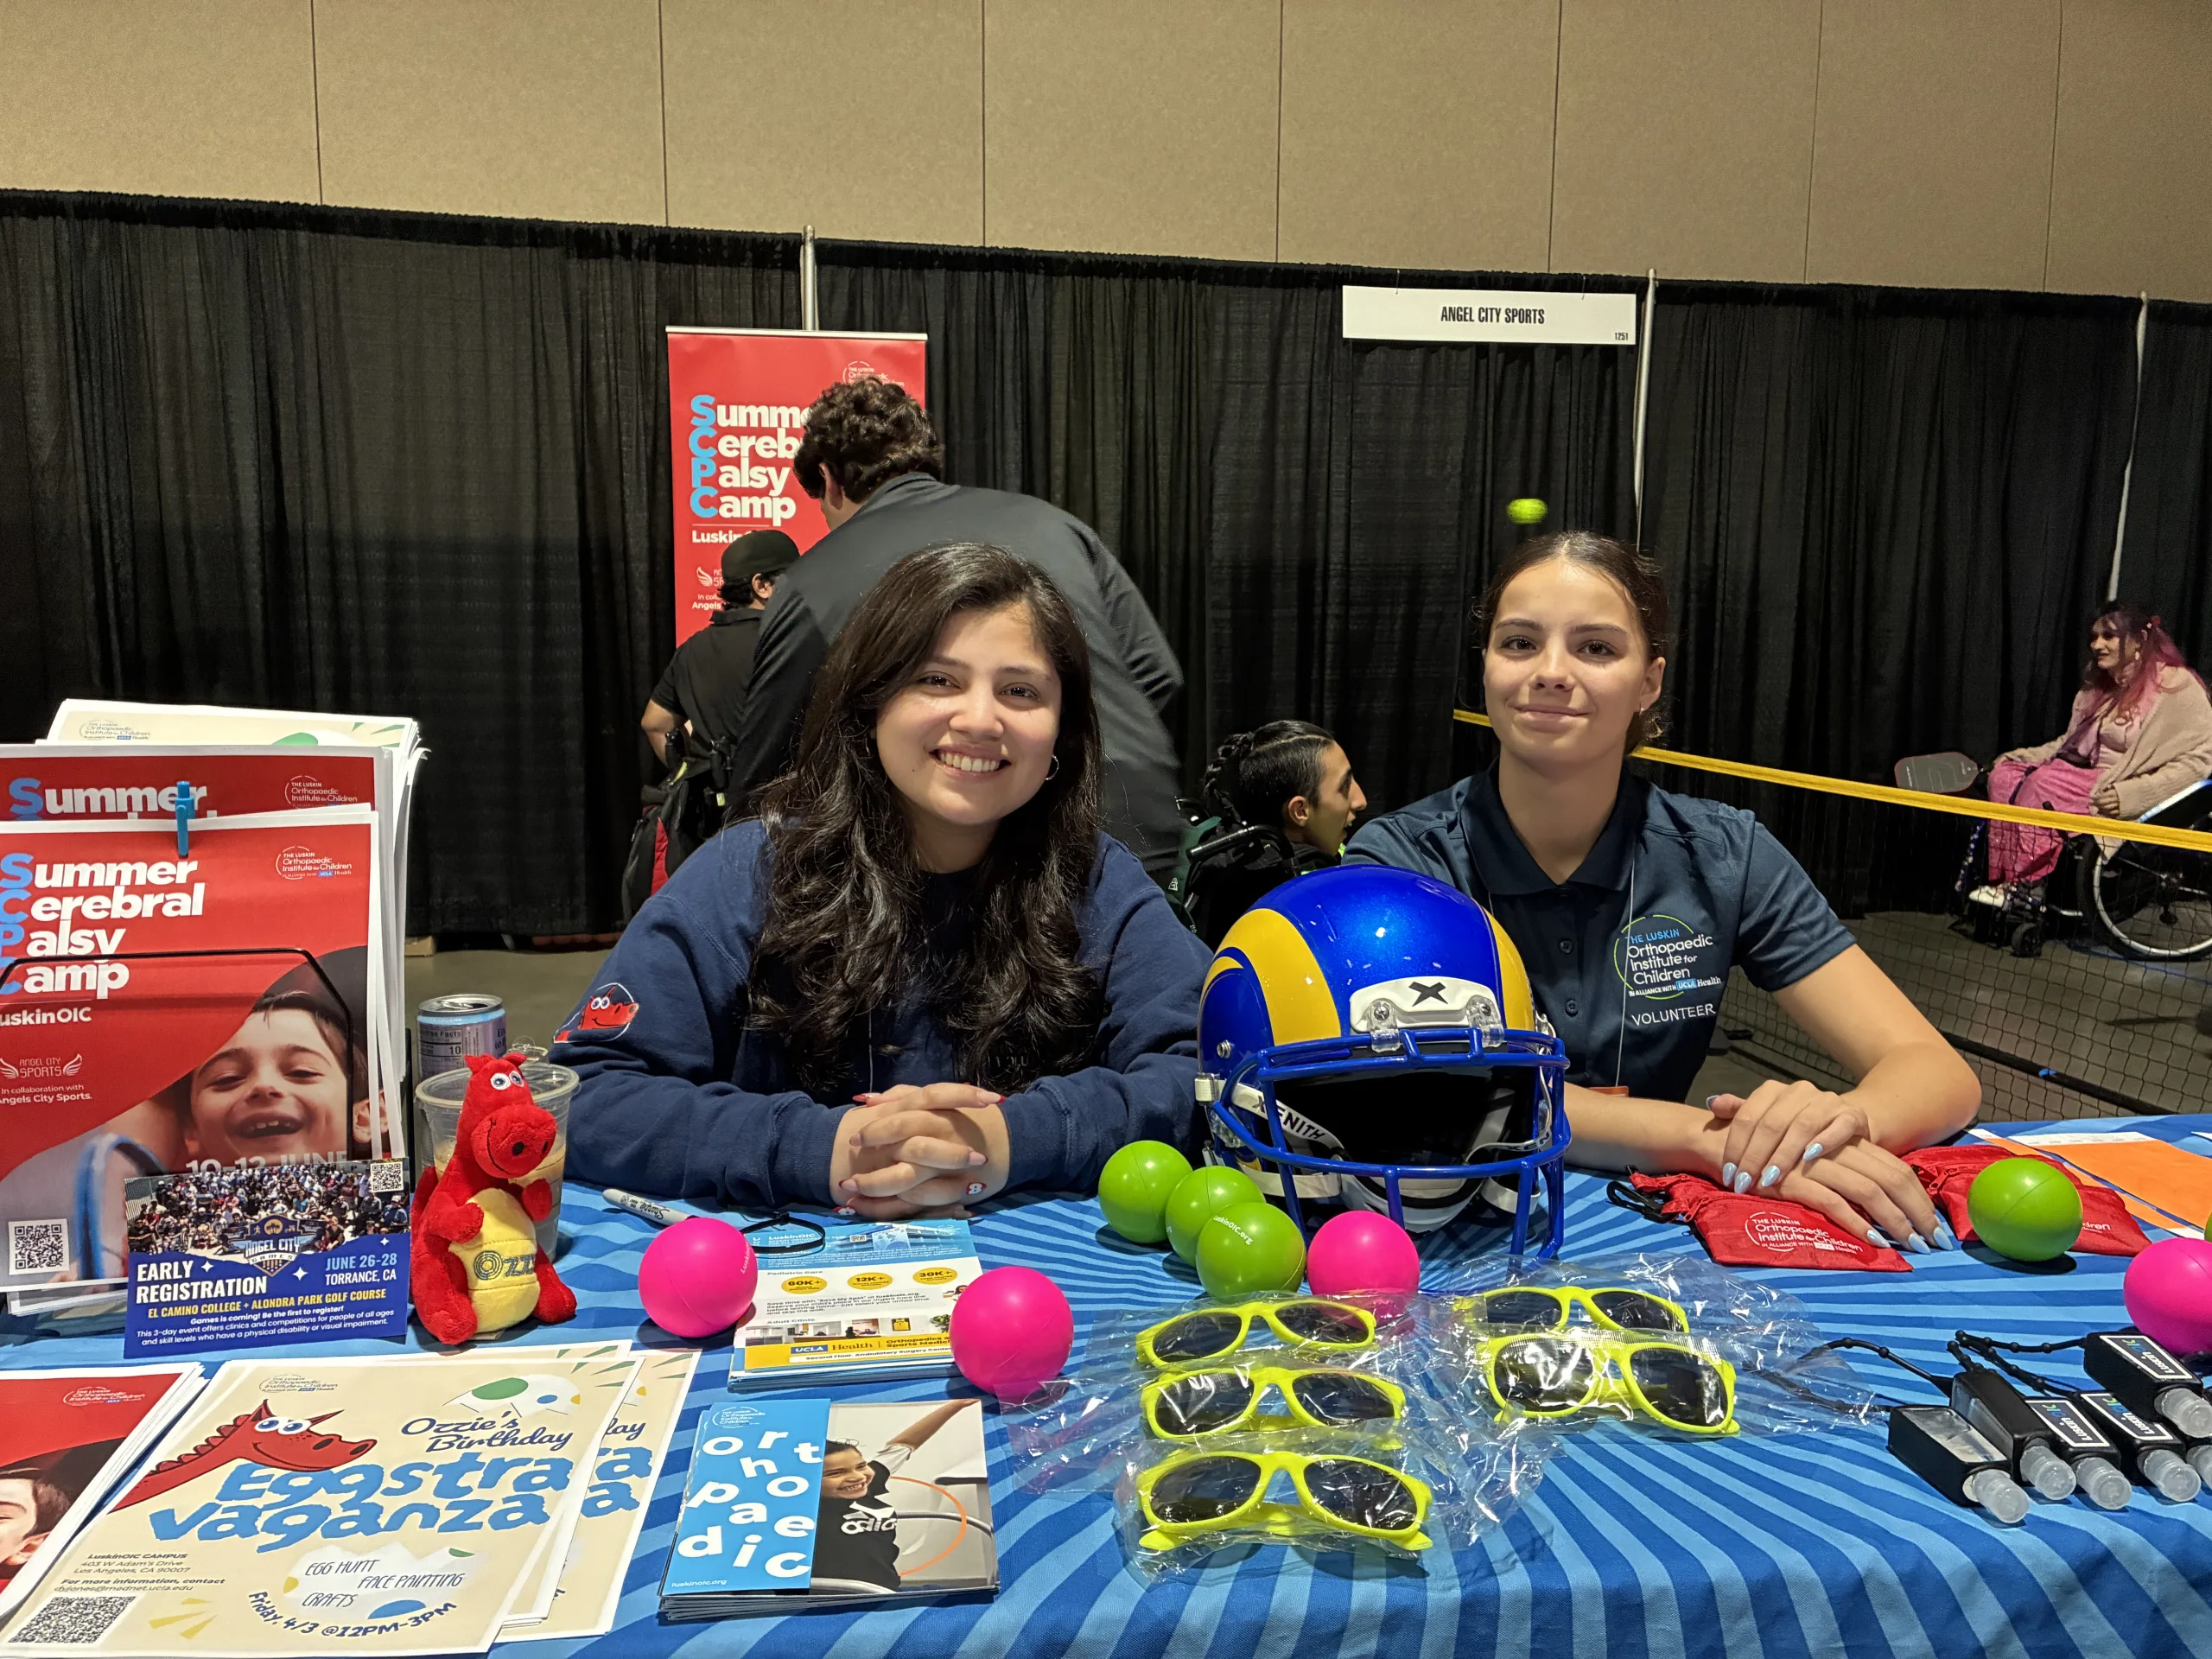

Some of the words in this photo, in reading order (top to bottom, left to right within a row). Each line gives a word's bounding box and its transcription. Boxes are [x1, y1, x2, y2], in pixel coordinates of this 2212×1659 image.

[1441, 306, 1474, 322] ANGEL
[1478, 307, 1502, 323] CITY
[1504, 308, 1545, 324] SPORTS
[1614, 332, 1629, 340] 1251
[690, 394, 812, 429] Summ
[689, 427, 802, 459] Cereb
[691, 456, 791, 496] Palsy
[690, 486, 796, 527] Camp
[0, 852, 198, 889] Summer
[0, 882, 205, 924] Cerebral
[1646, 928, 1681, 942] LUSKIN
[1627, 933, 1713, 958] Orthopaedic
[1630, 955, 1682, 972] Institute
[1683, 954, 1698, 964] for
[1633, 968, 1691, 985] Children
[1636, 987, 1662, 996] ALLIANCE
[1662, 984, 1677, 993] WITH
[1677, 980, 1696, 989] UCLA
[1697, 976, 1722, 988] Health
[0, 1007, 92, 1027] uskinOIC
[1630, 1003, 1717, 1027] VOLUNTEER
[449, 1046, 461, 1055] 10
[20, 1058, 43, 1066] ANGEL
[46, 1057, 60, 1065] CITY
[20, 1065, 62, 1078] SPORTS
[11, 1084, 64, 1093] collaboration
[34, 1094, 54, 1103] City
[56, 1092, 92, 1103] Sports.
[639, 1200, 670, 1220] Sharpie
[1213, 1215, 1253, 1245] LuskinOIC.org
[1755, 1224, 1830, 1238] Orthopaedic
[245, 1239, 276, 1257] ANGEL
[279, 1236, 300, 1253] CITY
[1758, 1232, 1804, 1242] Institute
[1815, 1235, 1864, 1252] Children
[137, 1260, 194, 1282] EARLY
[325, 1255, 356, 1271] JUNE
[359, 1253, 397, 1268] 26-28
[325, 1271, 380, 1286] TORRANCE,
[383, 1268, 397, 1281] CA
[136, 1275, 268, 1304] REGISTRATION
[148, 1308, 158, 1319] EL
[161, 1305, 199, 1318] CAMINO
[200, 1301, 242, 1314] COLLEGE
[251, 1296, 296, 1309] ALONDRA
[297, 1294, 323, 1306] PARK
[325, 1292, 347, 1303] GOLF
[350, 1288, 387, 1301] COURSE
[153, 1328, 177, 1338] 3-day
[178, 1326, 200, 1335] event
[267, 1316, 316, 1328] competitions
[328, 1313, 355, 1324] people
[375, 1310, 394, 1319] ages
[228, 1313, 261, 1323] coming!
[174, 1335, 196, 1344] levels
[215, 1332, 236, 1340] have
[244, 1329, 276, 1340] physical
[276, 1324, 310, 1336] disability
[343, 1318, 389, 1330] impairment.
[832, 1342, 874, 1351] Health
[401, 1411, 519, 1435] Ozzie's
[425, 1427, 574, 1452] Birthday
[215, 1452, 574, 1511] Eggstra
[304, 1561, 334, 1576] EGG
[335, 1559, 380, 1574] HUNT
[357, 1574, 397, 1589] FACE
[394, 1573, 466, 1588] PAINTING
[671, 1579, 728, 1588] luskinoic.org
[302, 1592, 359, 1608] CRAFTS
[283, 1618, 319, 1635] 4/3
[321, 1601, 458, 1637] @12PM-3PM
